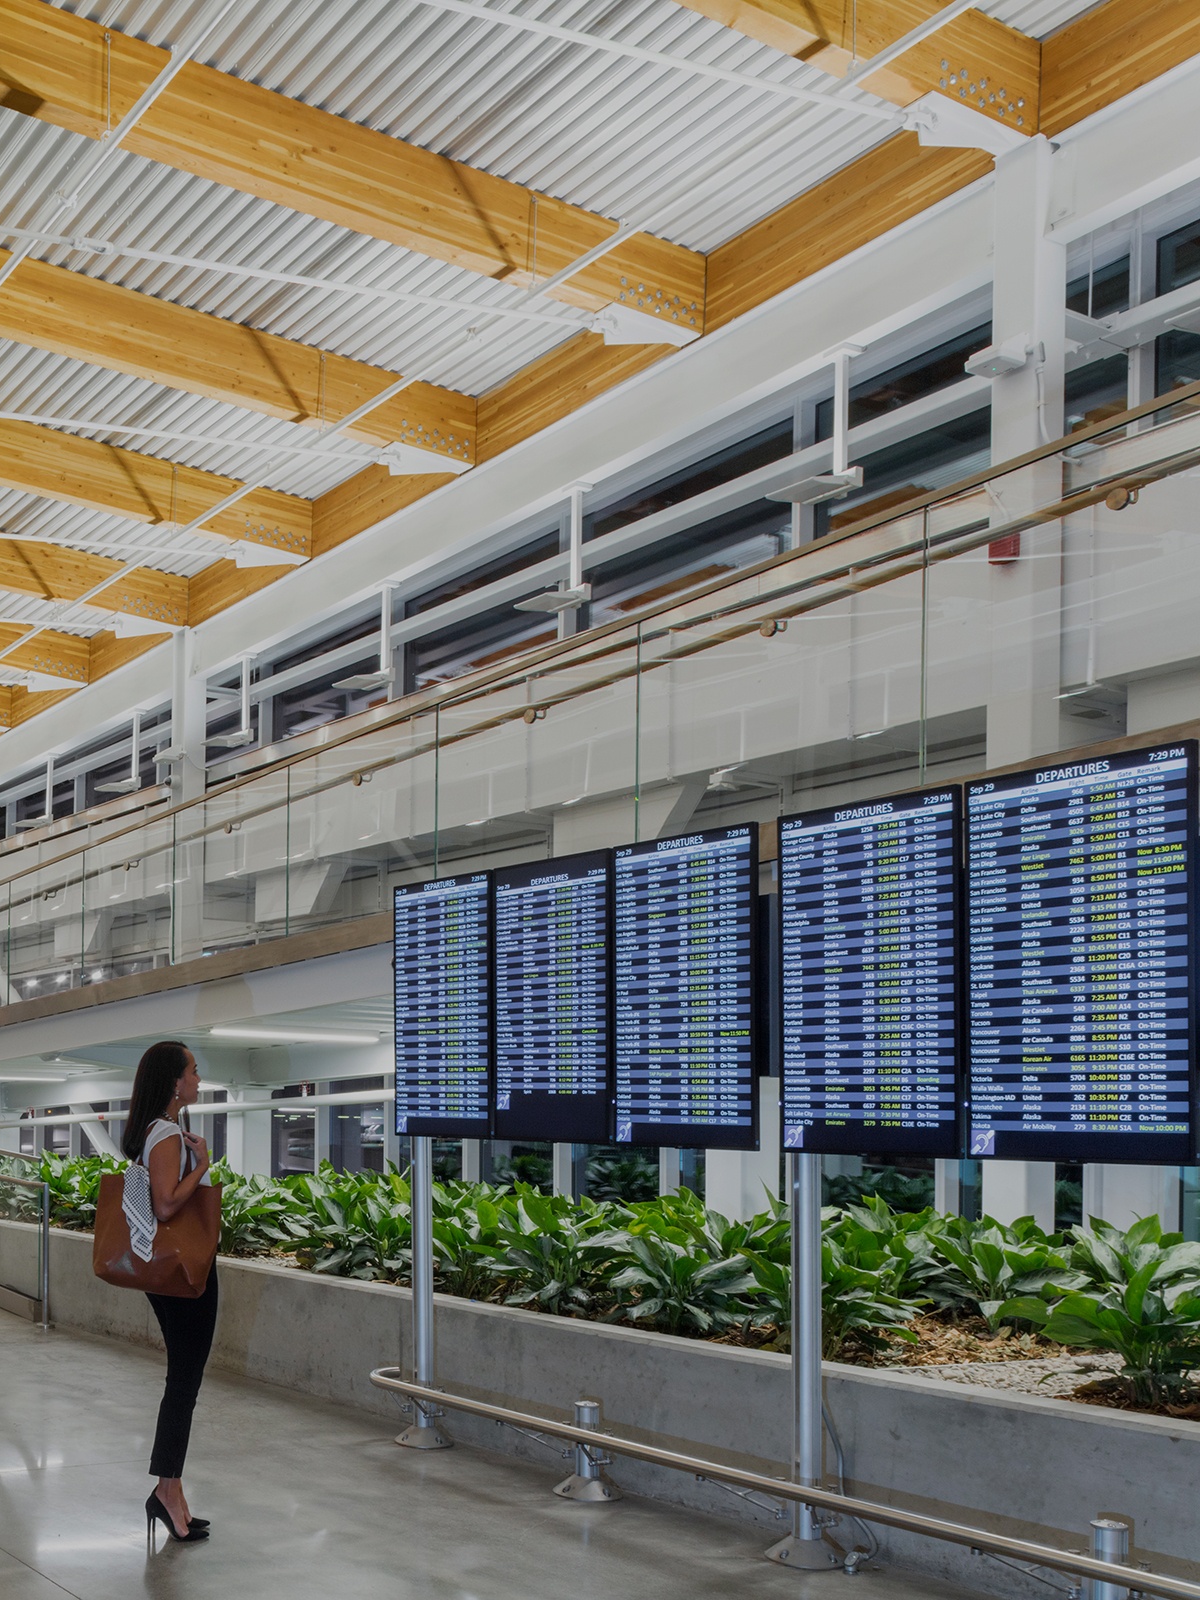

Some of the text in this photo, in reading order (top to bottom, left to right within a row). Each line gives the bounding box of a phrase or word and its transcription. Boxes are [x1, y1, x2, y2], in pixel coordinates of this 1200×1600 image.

[1148, 747, 1184, 762] 7:29 PM
[1036, 760, 1108, 783] DEPARTURES
[1020, 786, 1038, 795] Airline
[1094, 774, 1108, 782] Time
[1117, 770, 1131, 778] Gate
[1136, 764, 1160, 774] Remark
[968, 805, 979, 813] Salt
[980, 802, 993, 811] Lake
[993, 800, 1005, 810] City
[1020, 796, 1039, 804] Alaska
[1136, 772, 1165, 785] On-Time
[970, 782, 994, 795] Sep 29
[923, 792, 952, 804] 7:29 PM
[1020, 806, 1036, 814] Delta
[1136, 784, 1165, 794] On-Time
[834, 802, 892, 821] DEPARTURES
[782, 821, 793, 830] Sep
[980, 830, 1003, 839] Antonio
[1020, 822, 1051, 833] Southwest
[1136, 805, 1165, 815] On-Time
[727, 829, 738, 837] 7:29
[657, 834, 702, 851] DEPARTURES
[980, 868, 1006, 876] Francisco
[424, 879, 455, 891] DEPARTURES
[531, 874, 568, 886] DEPARTURES
[1020, 900, 1041, 909] United
[1136, 888, 1165, 896] On-Time
[970, 934, 993, 944] Spokane
[1136, 917, 1165, 927] On-Time
[1021, 978, 1052, 986] Southwest
[1137, 970, 1166, 978] On-Time
[1137, 990, 1166, 998] On-Time
[971, 1094, 1016, 1102] Washington-IAD
